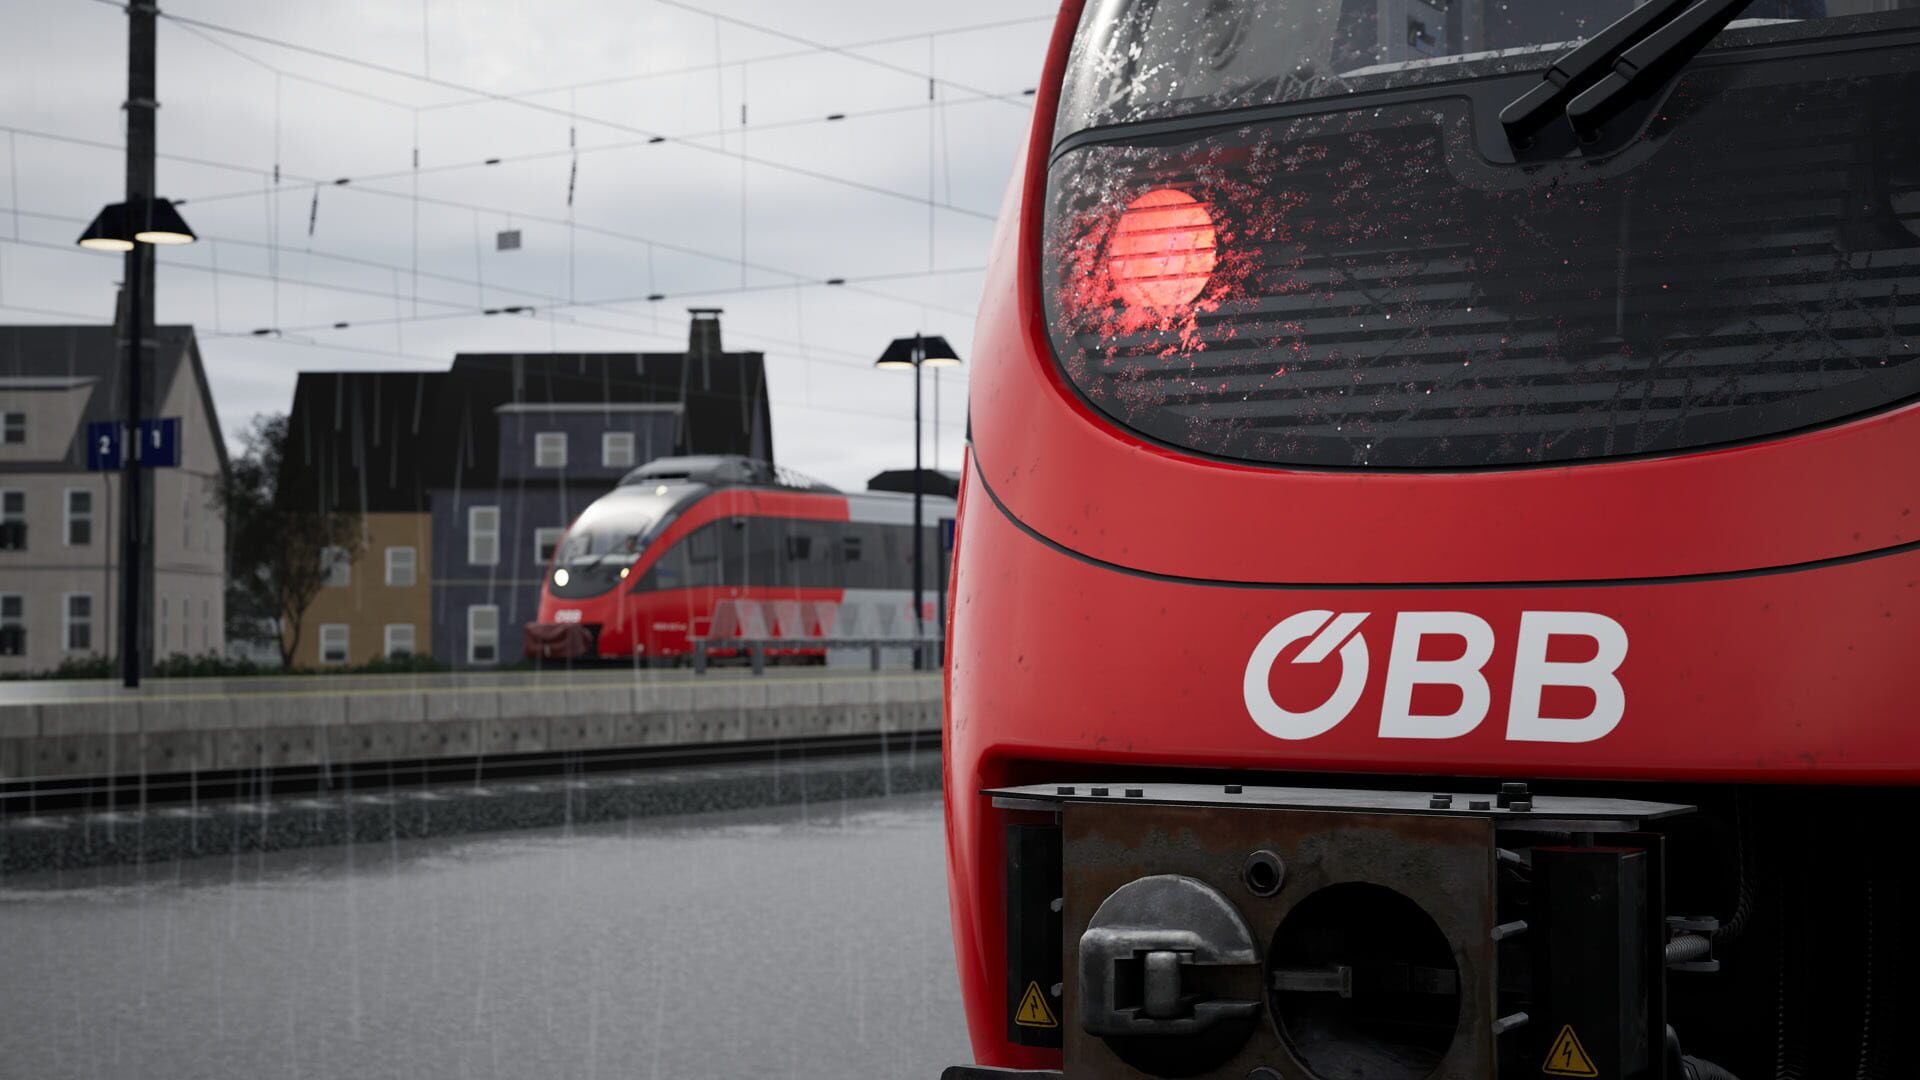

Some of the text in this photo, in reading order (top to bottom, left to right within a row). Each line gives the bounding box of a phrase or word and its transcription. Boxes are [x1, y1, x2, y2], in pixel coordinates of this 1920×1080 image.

[99, 435, 111, 455] 2
[151, 429, 161, 449] 1
[1243, 609, 1629, 743] ÖBB
